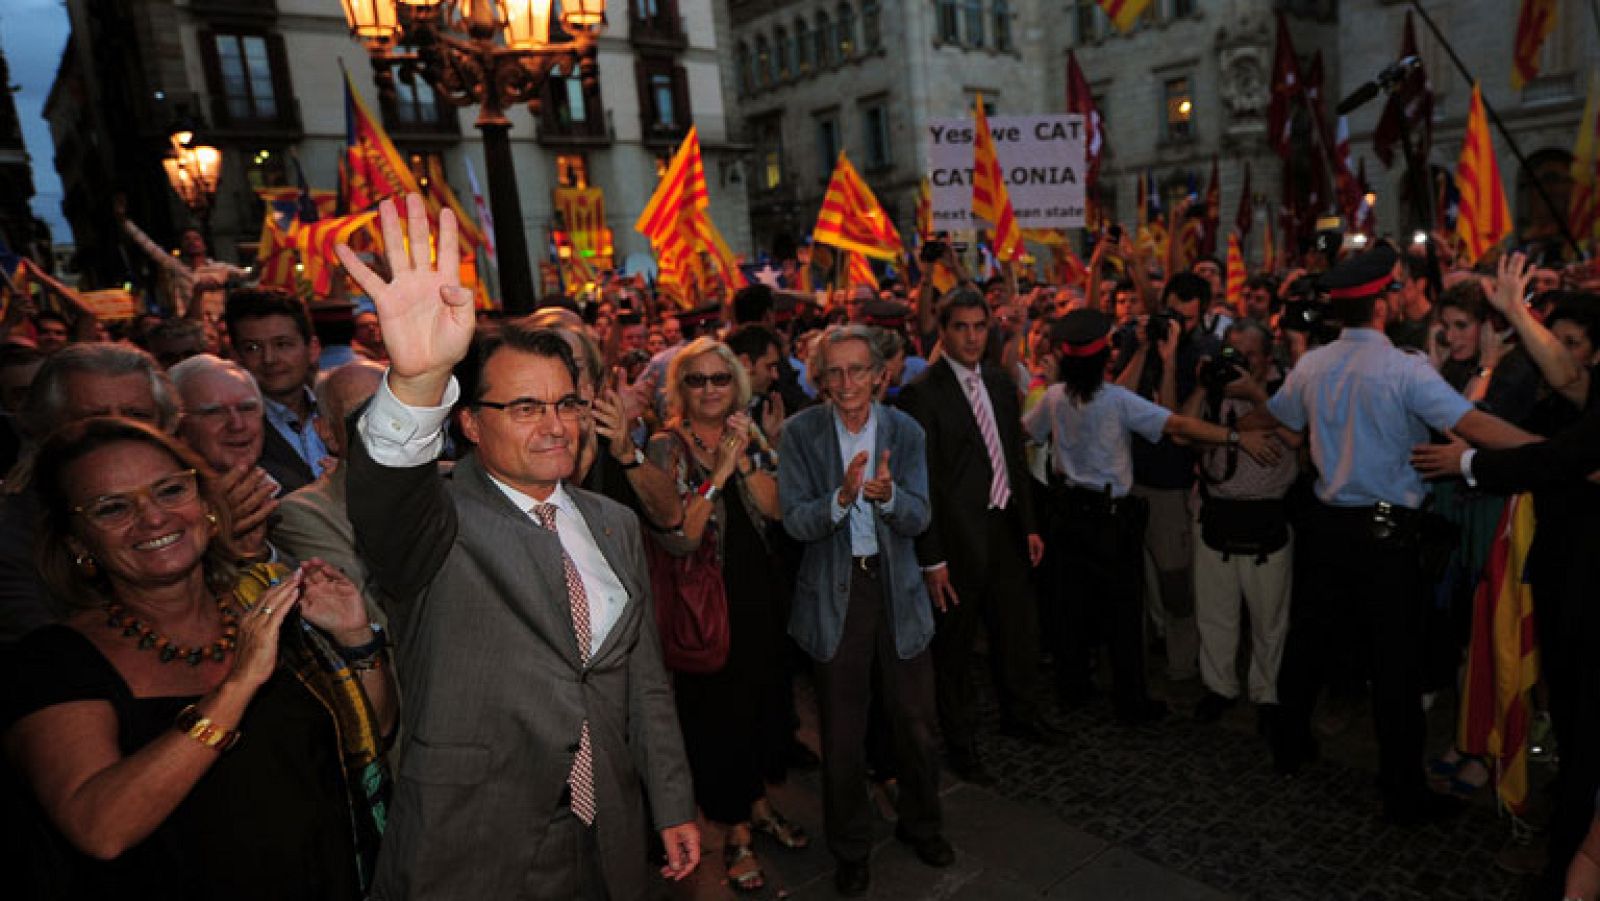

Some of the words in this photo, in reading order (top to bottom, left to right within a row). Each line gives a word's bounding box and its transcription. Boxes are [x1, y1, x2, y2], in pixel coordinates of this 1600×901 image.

[930, 125, 973, 144] Yes
[1035, 120, 1083, 141] CAT
[932, 165, 1076, 187] CATONIA
[1045, 205, 1085, 218] state
